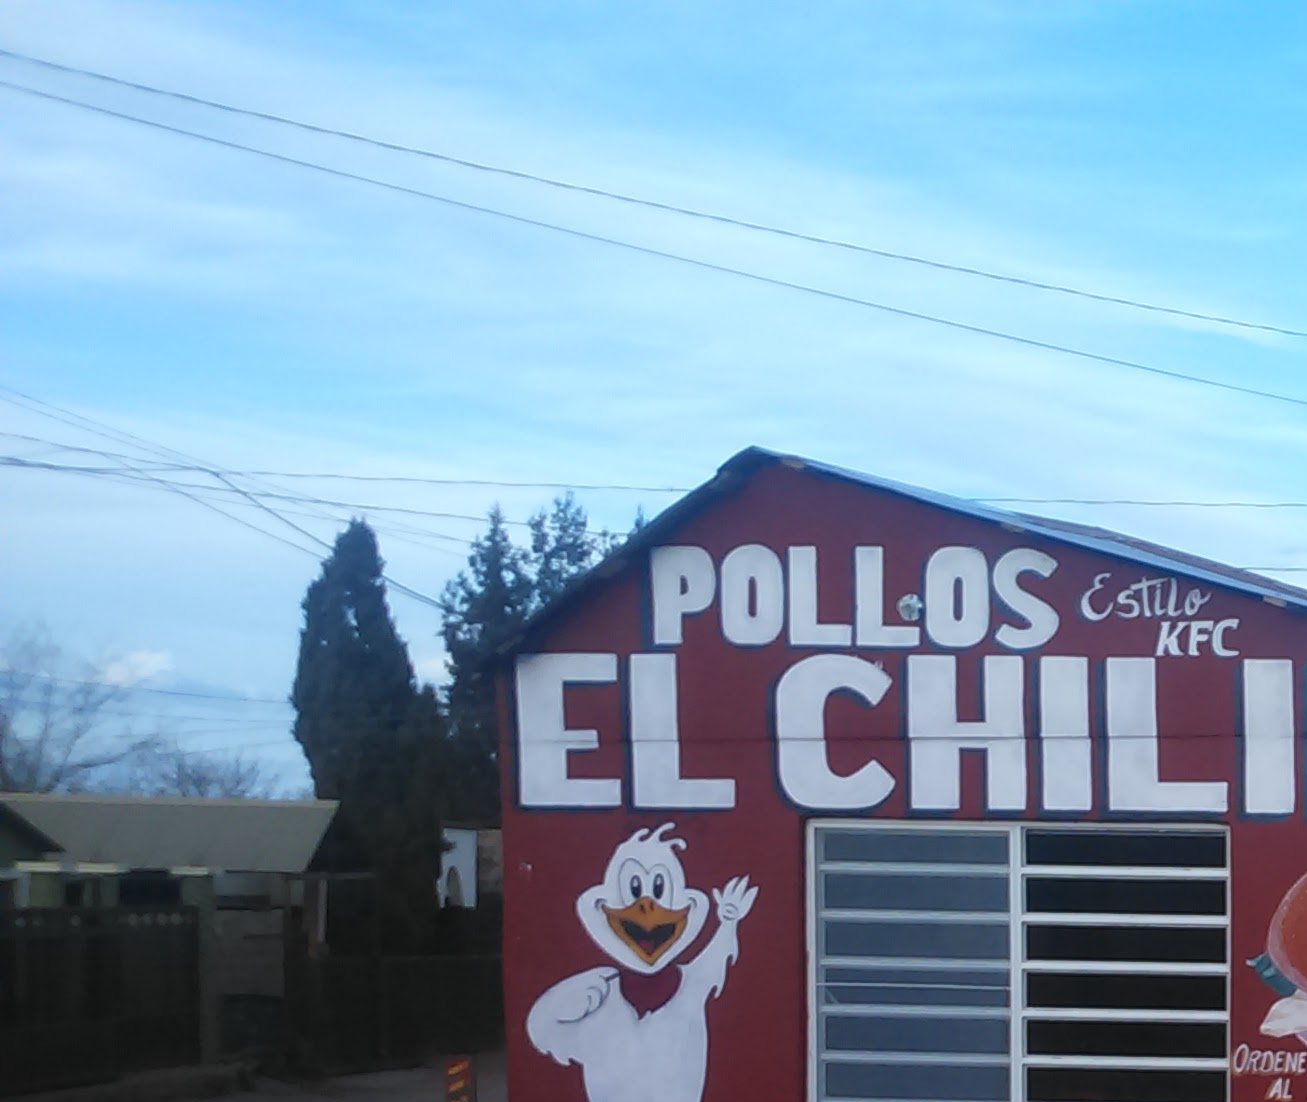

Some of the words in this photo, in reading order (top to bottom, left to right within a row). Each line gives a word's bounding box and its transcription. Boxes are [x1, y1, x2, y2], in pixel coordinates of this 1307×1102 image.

[650, 545, 1059, 649] POLLOS
[1081, 572, 1212, 622] Estilo
[1154, 618, 1240, 657] KFC
[514, 653, 736, 812] EL
[1233, 1043, 1307, 1073] ORDENE
[1268, 1078, 1293, 1099] AL
